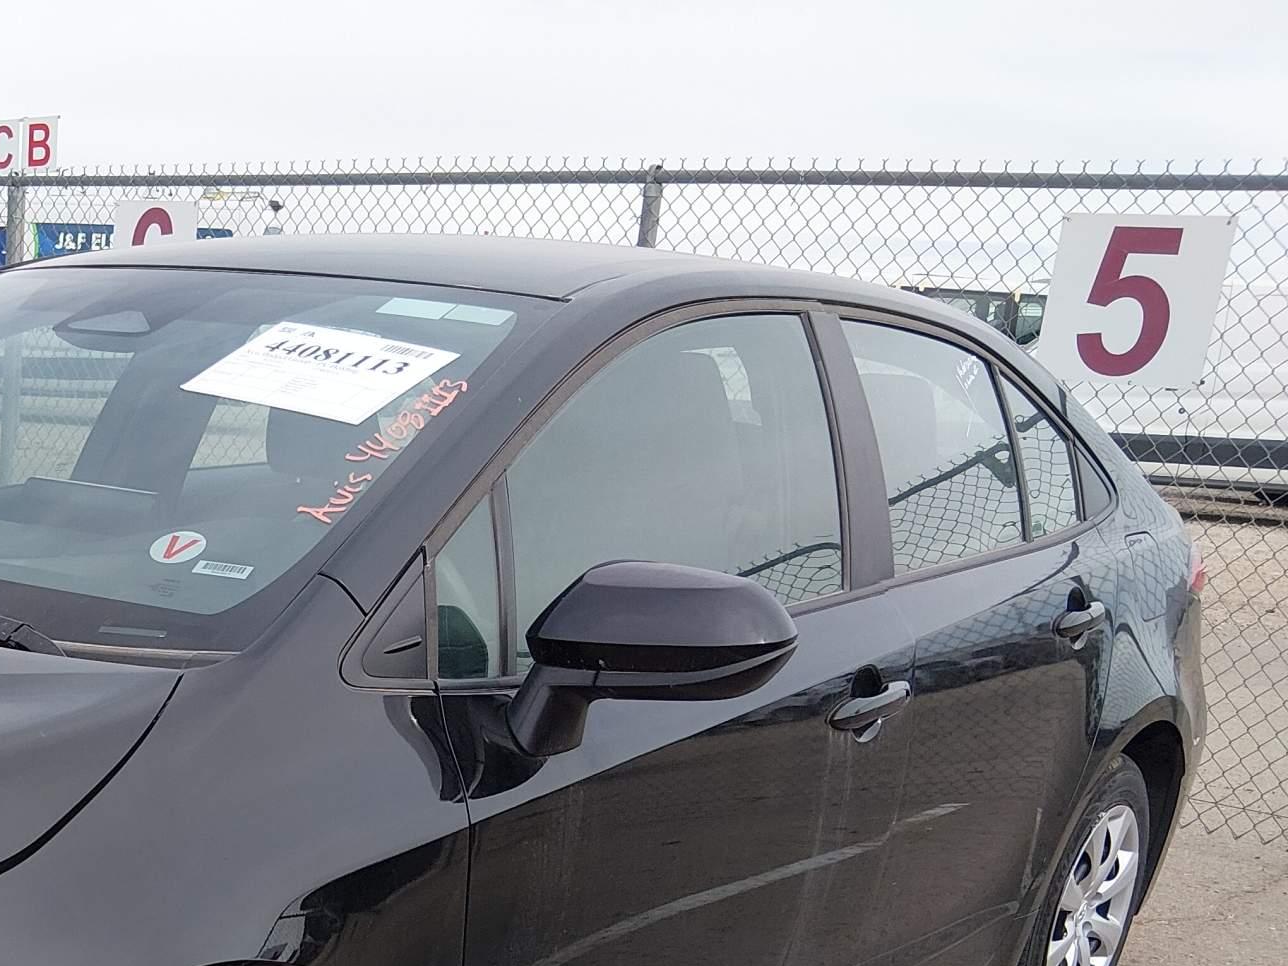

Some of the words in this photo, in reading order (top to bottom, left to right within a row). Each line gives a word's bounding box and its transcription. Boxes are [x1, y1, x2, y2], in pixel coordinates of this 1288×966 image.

[28, 123, 51, 167] B
[1076, 225, 1184, 377] 5
[265, 339, 410, 376] 44081113
[162, 534, 201, 560] V
